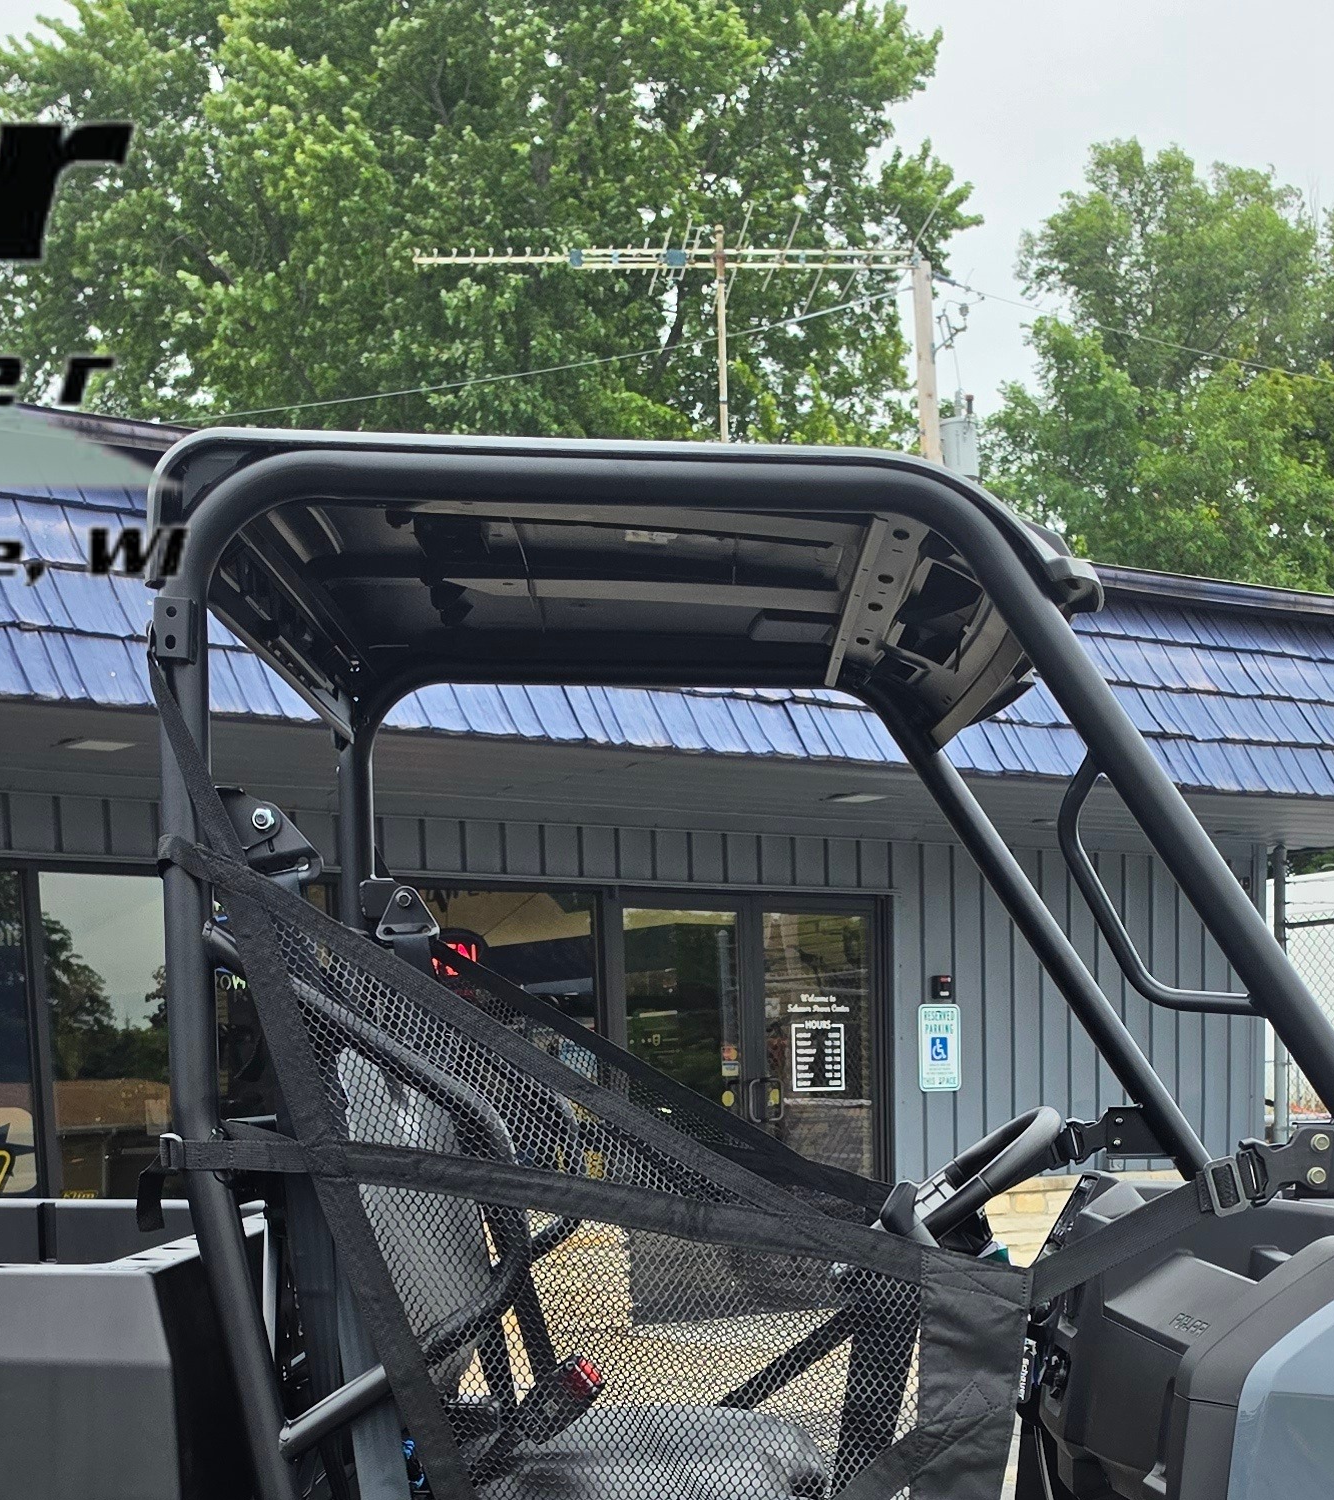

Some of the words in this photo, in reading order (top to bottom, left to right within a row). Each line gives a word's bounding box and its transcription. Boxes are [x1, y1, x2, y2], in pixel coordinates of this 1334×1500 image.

[924, 1010, 955, 1021] RESERVED
[804, 1020, 831, 1029] HOURS
[925, 1024, 953, 1034] PARKING
[939, 1077, 957, 1085] SPACE
